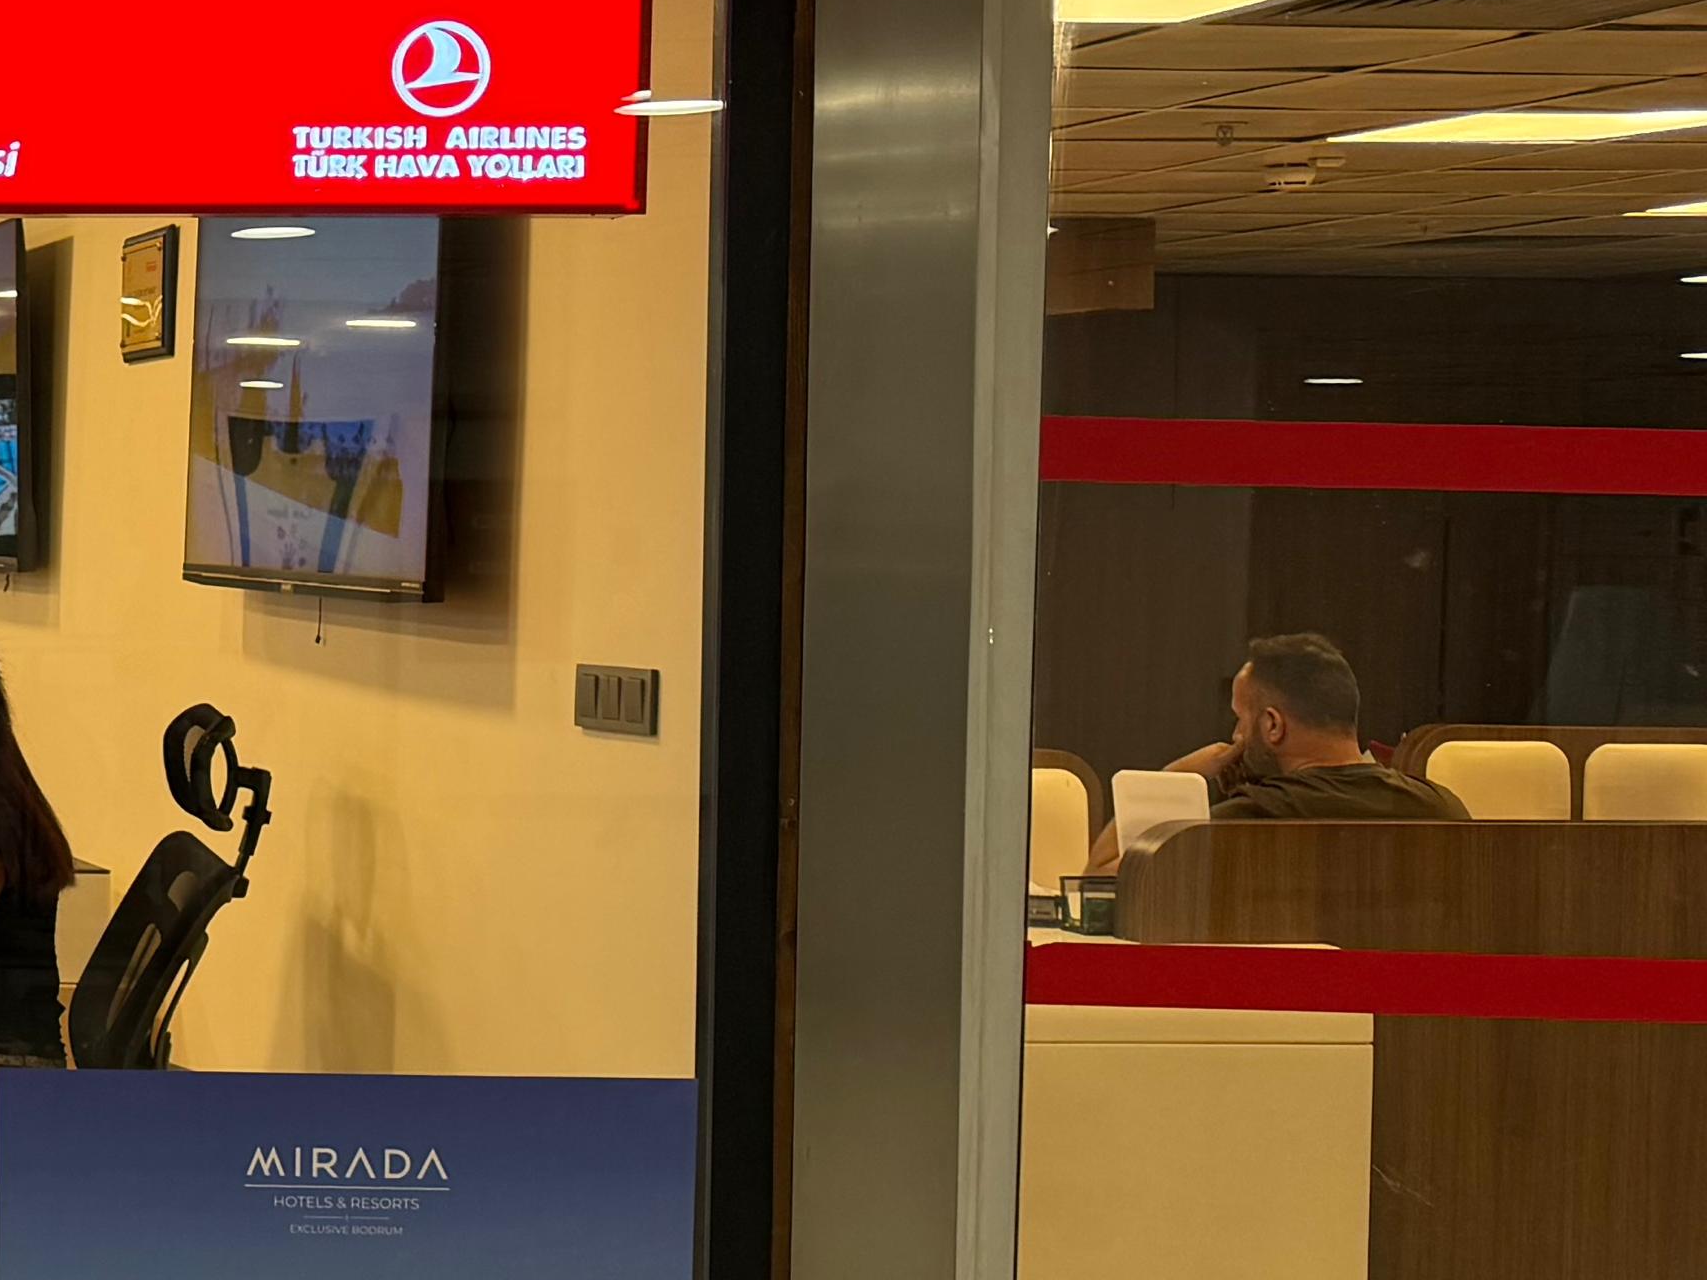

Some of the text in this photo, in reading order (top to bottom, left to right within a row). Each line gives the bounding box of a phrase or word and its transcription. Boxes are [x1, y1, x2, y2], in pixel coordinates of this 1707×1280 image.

[292, 126, 587, 150] TURKISH AIRLINES
[292, 150, 585, 181] TÜRK HAVA YOLLARI
[246, 1146, 449, 1180] MIRADA
[273, 1195, 420, 1210] HOTELS & RESORTS
[289, 1223, 404, 1236] EXCLUSIVE BODRUM
